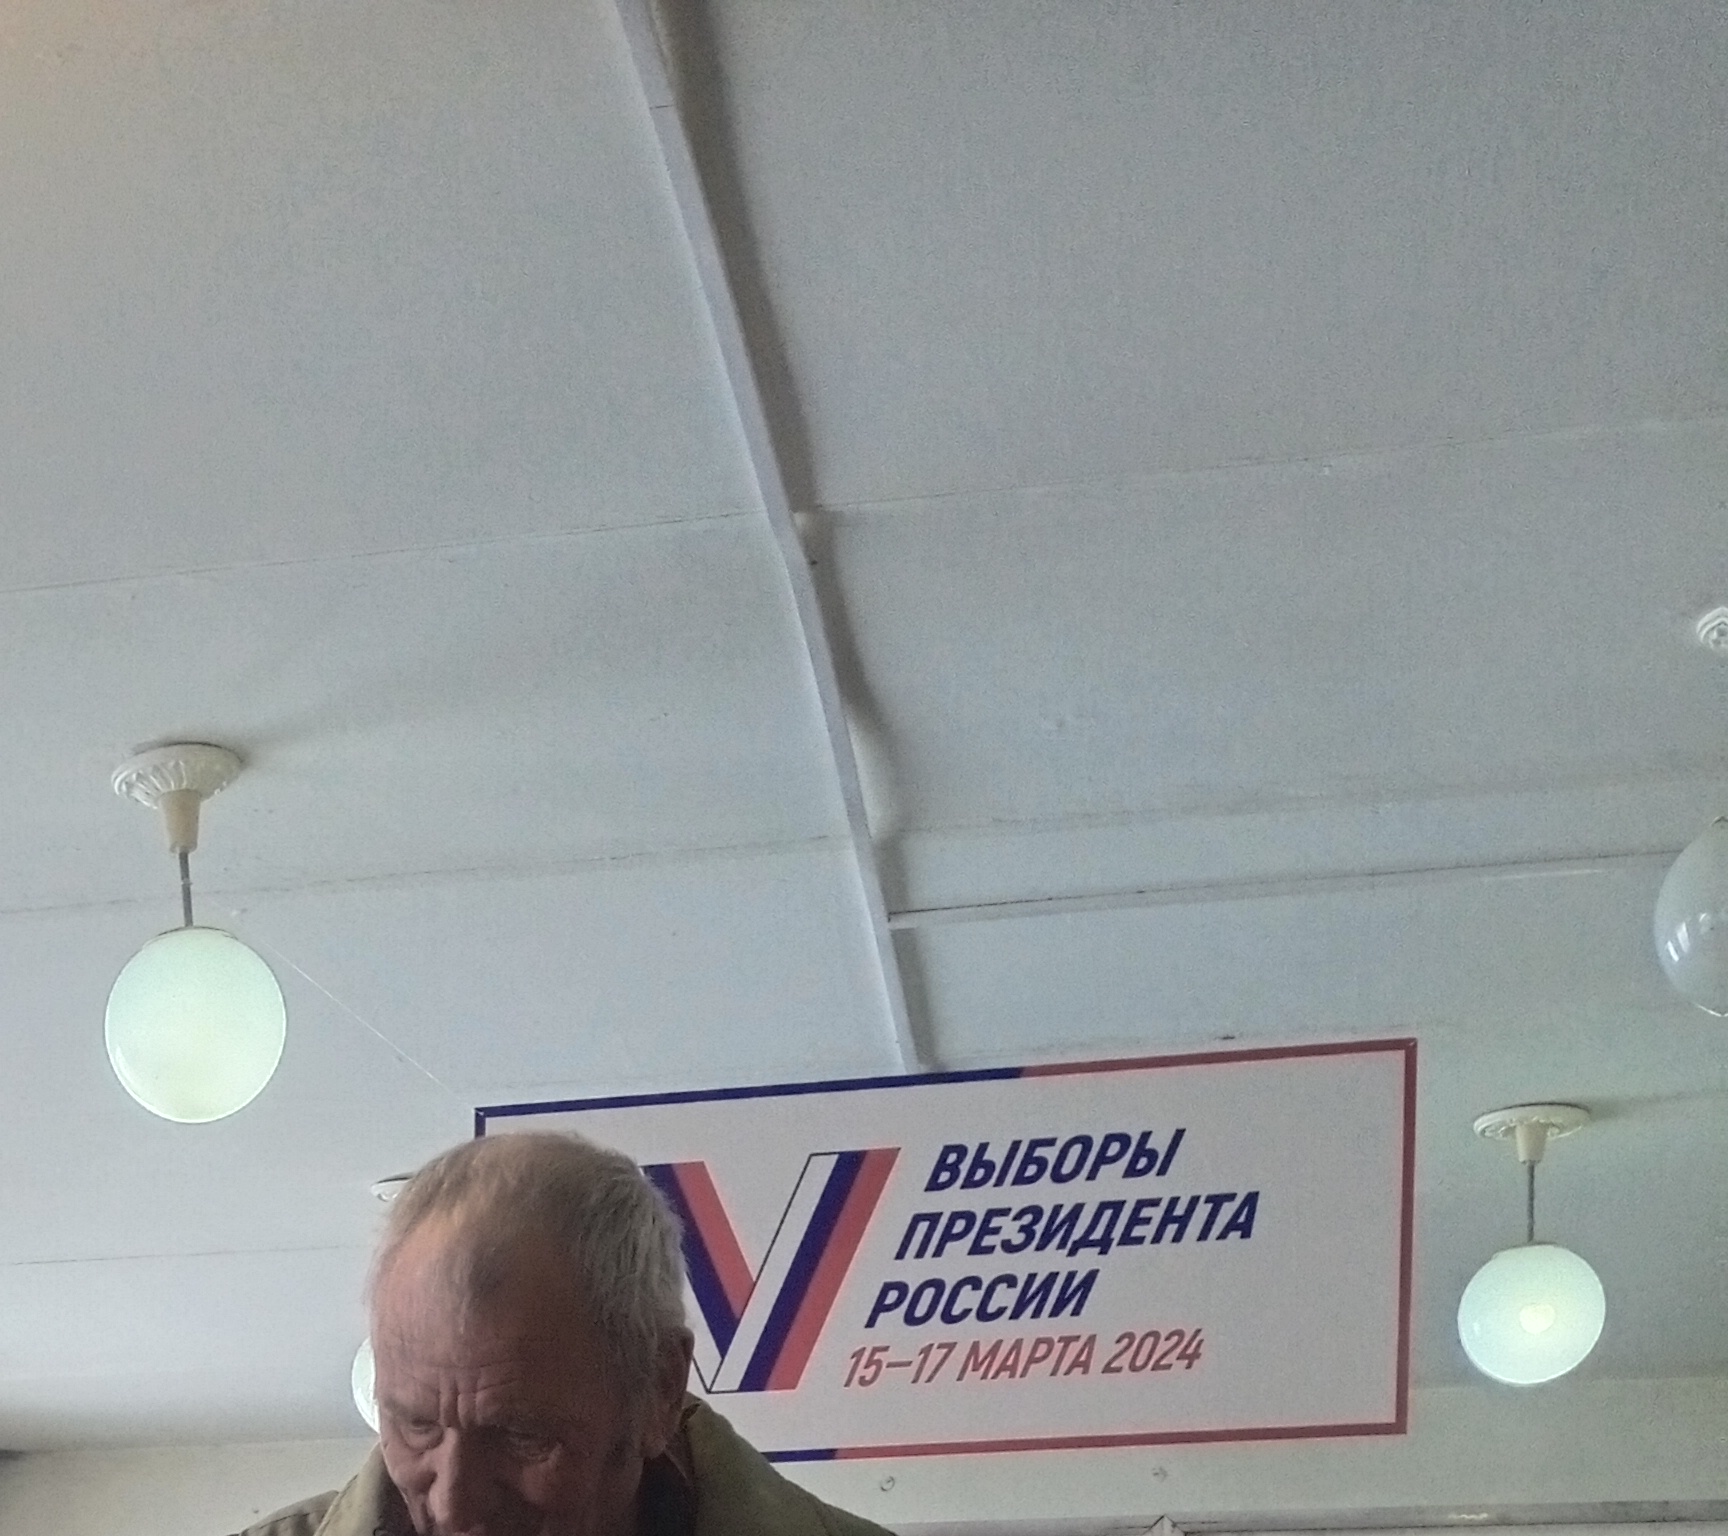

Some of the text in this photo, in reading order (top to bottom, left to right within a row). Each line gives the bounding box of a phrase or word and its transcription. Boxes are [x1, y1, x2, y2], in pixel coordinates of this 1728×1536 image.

[924, 1128, 1186, 1193] ВЫБОРЫ
[894, 1191, 1260, 1262] ПРЕЗИДЕНТА
[864, 1268, 1100, 1331] РОССИИ
[957, 1333, 1096, 1387] МАРТА
[1102, 1327, 1205, 1378] 2024
